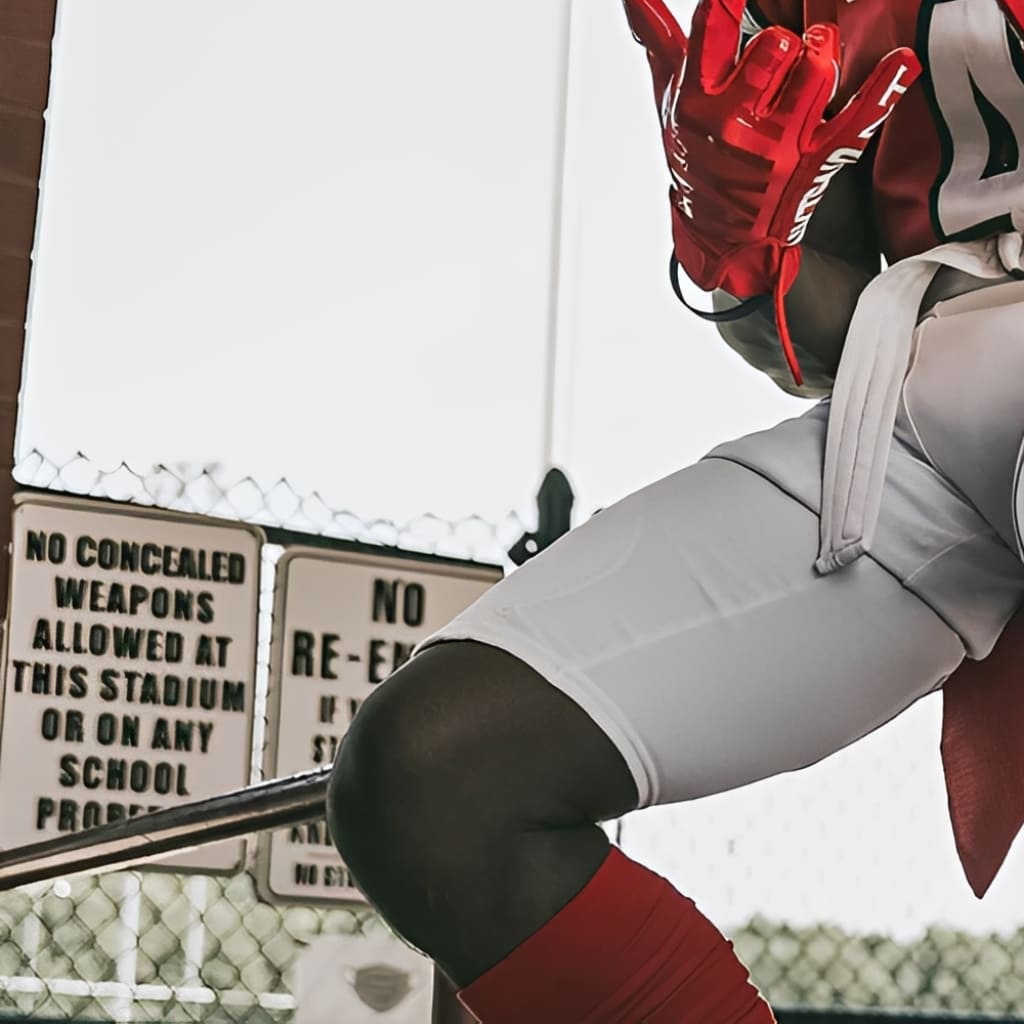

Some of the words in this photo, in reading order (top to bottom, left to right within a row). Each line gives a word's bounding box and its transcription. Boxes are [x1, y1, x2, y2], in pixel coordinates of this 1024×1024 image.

[26, 530, 67, 564] NO
[76, 535, 246, 585] CONCEALED
[55, 576, 215, 623] WEAPONS
[372, 578, 425, 627] NO
[32, 619, 184, 663] ALLOWED
[195, 634, 233, 667] AT
[12, 660, 89, 699] THIS
[99, 668, 246, 712] STADIUM
[41, 708, 84, 742] OR
[97, 712, 140, 747] ON
[151, 718, 214, 753] ANY
[58, 754, 191, 796] SCHOOL
